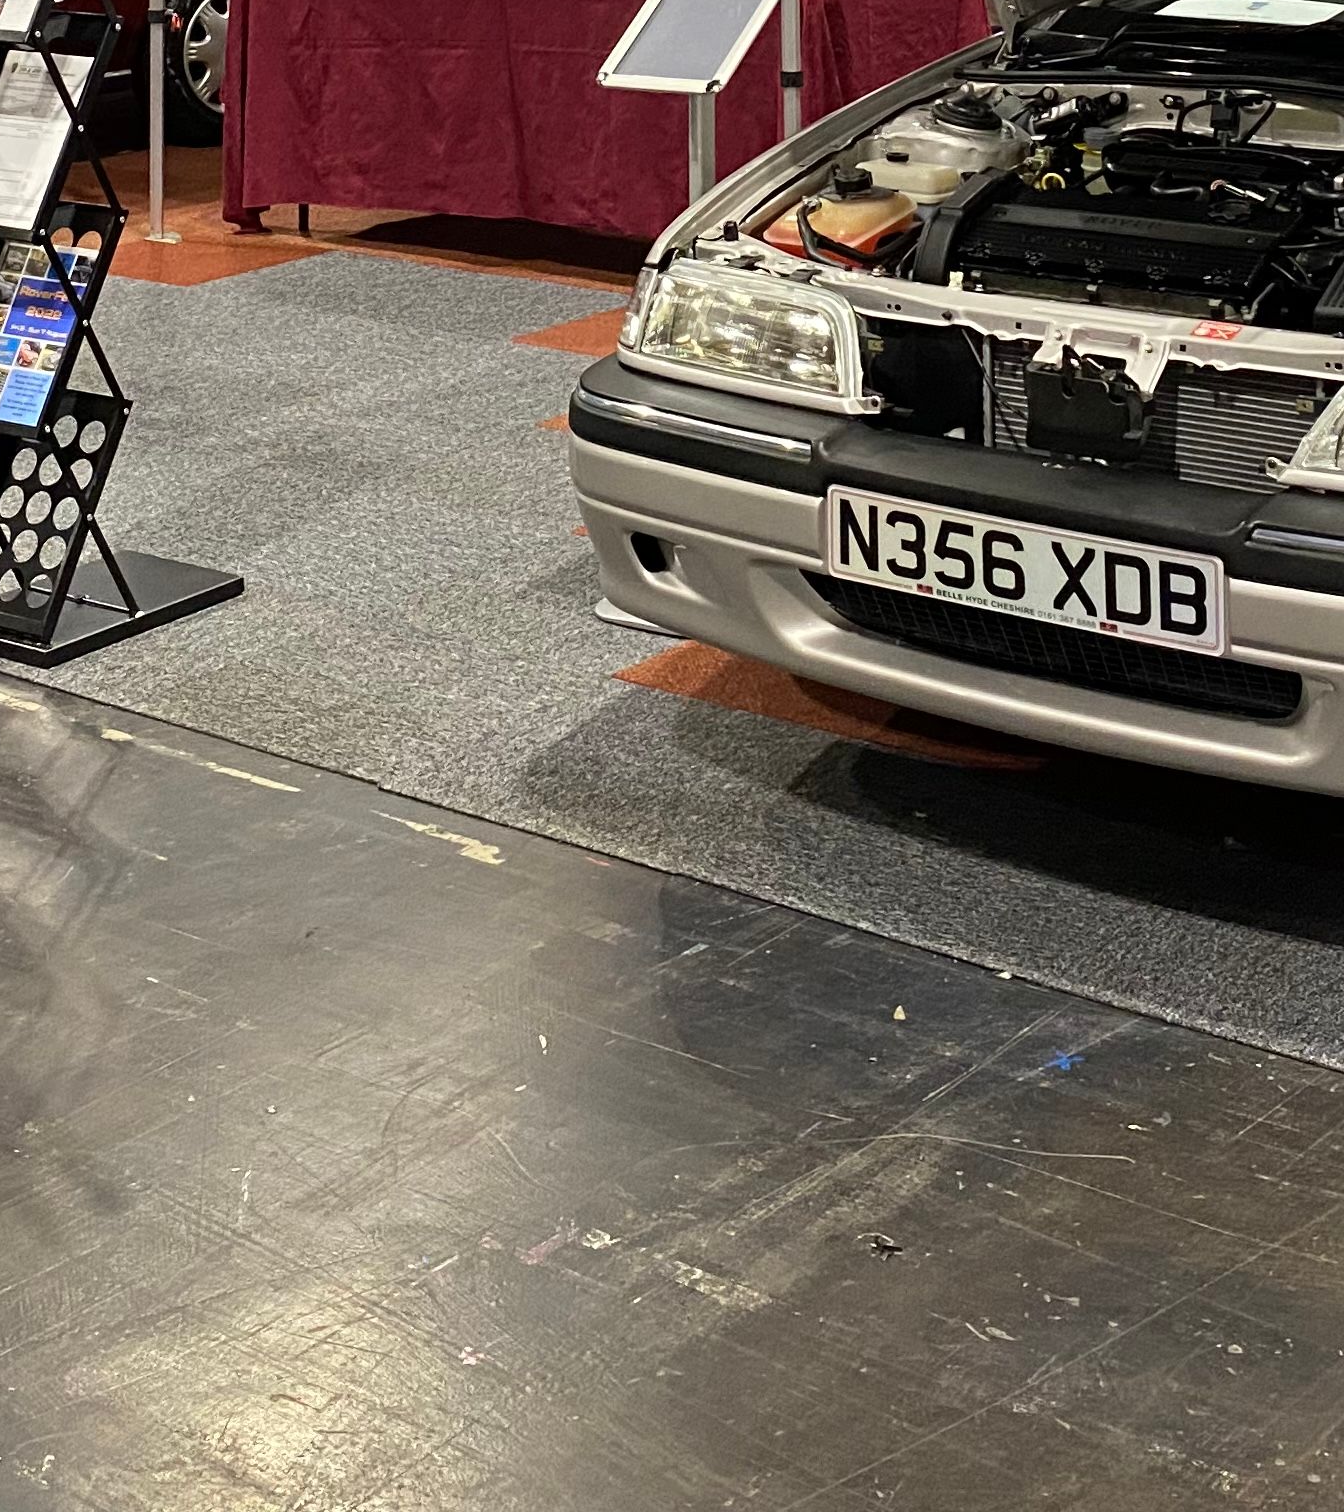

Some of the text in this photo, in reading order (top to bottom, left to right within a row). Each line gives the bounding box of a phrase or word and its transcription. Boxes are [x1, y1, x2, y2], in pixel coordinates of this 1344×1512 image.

[839, 498, 1208, 637] N356 XDB
[936, 588, 964, 601] BELLS
[965, 595, 988, 607] HYDE
[991, 600, 1035, 616] CHESHIRE
